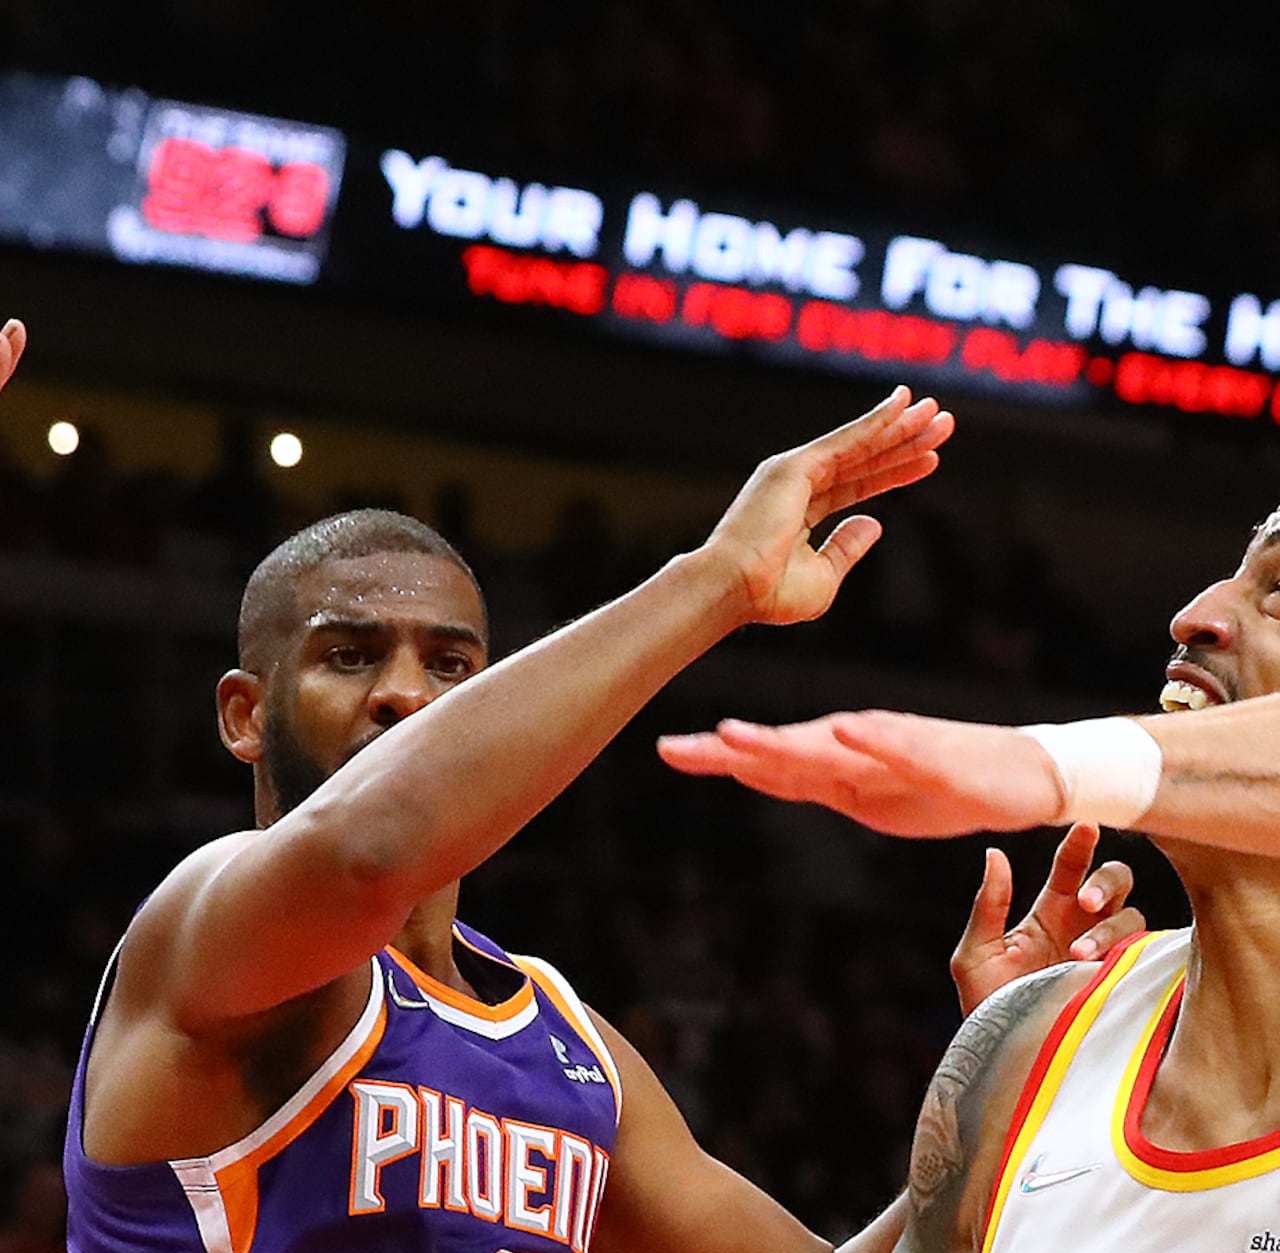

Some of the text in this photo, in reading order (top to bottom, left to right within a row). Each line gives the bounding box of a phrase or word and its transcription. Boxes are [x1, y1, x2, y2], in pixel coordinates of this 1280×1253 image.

[380, 148, 603, 258] YOUR
[622, 192, 866, 299] HOME
[881, 235, 1040, 329] FOR
[1053, 263, 1211, 357] THE
[563, 1065, 606, 1084] ayPal
